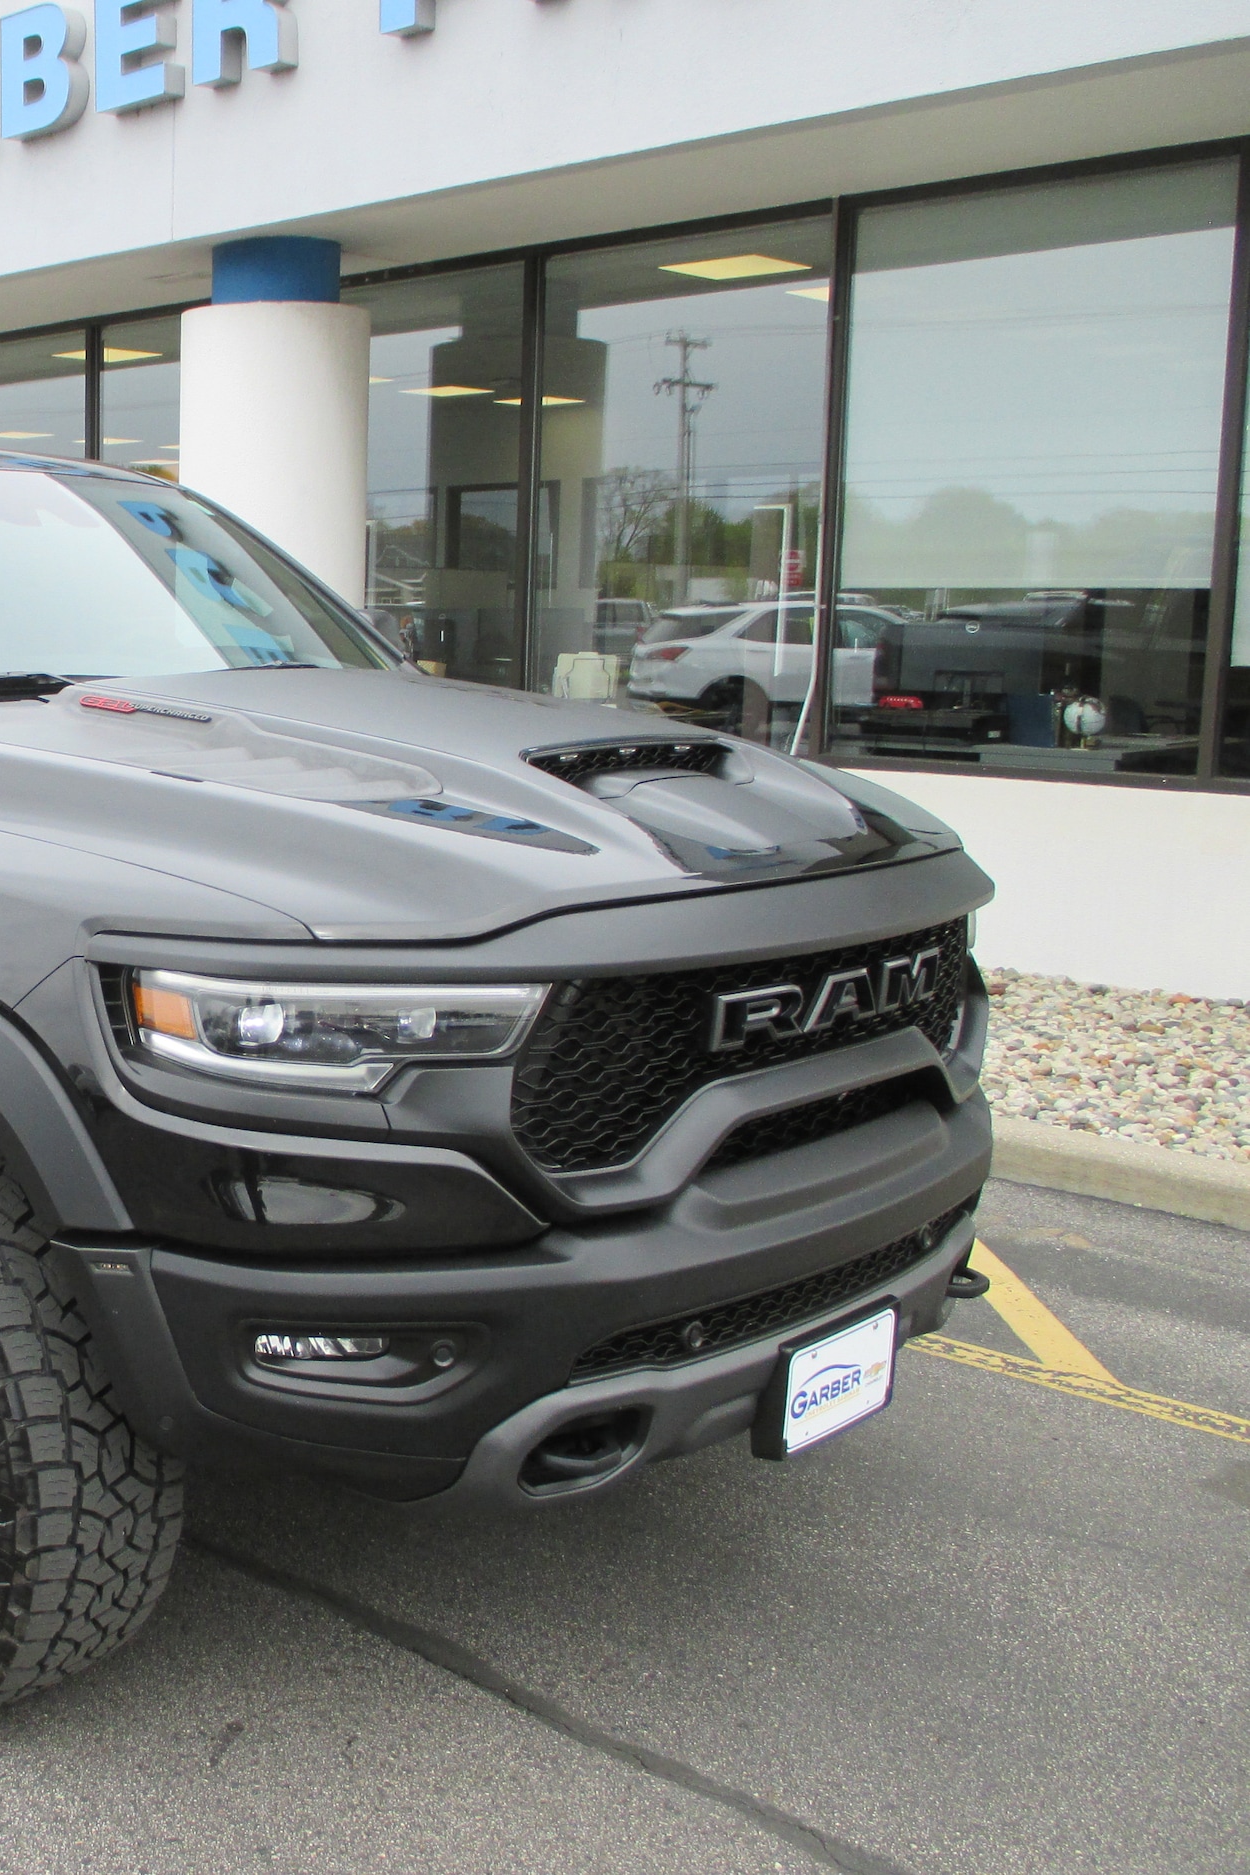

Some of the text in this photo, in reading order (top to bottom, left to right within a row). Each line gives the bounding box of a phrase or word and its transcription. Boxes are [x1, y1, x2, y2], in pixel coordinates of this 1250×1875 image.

[129, 702, 209, 721] SUPERCHARGED
[710, 946, 941, 1051] RAM
[791, 1369, 861, 1419] GARBER
